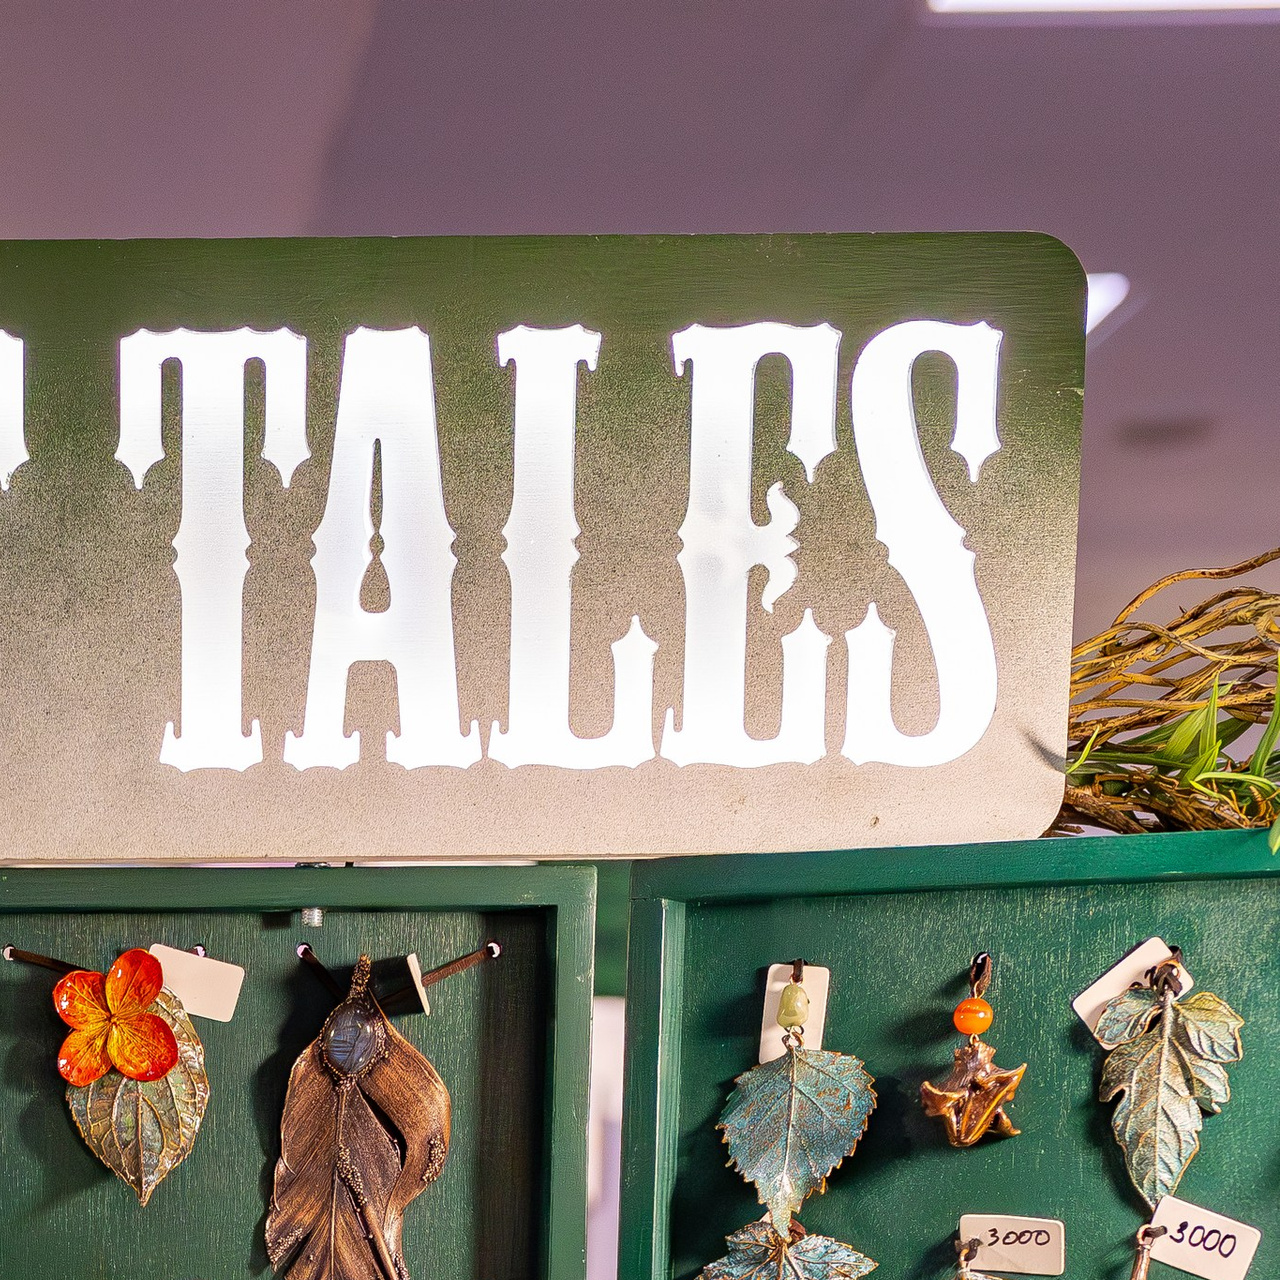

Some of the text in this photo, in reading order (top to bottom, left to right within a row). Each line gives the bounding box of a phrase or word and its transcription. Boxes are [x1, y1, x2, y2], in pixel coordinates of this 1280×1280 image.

[114, 320, 1004, 774] TALES
[988, 1228, 1051, 1246] 3000
[1170, 1221, 1237, 1258] 3000
